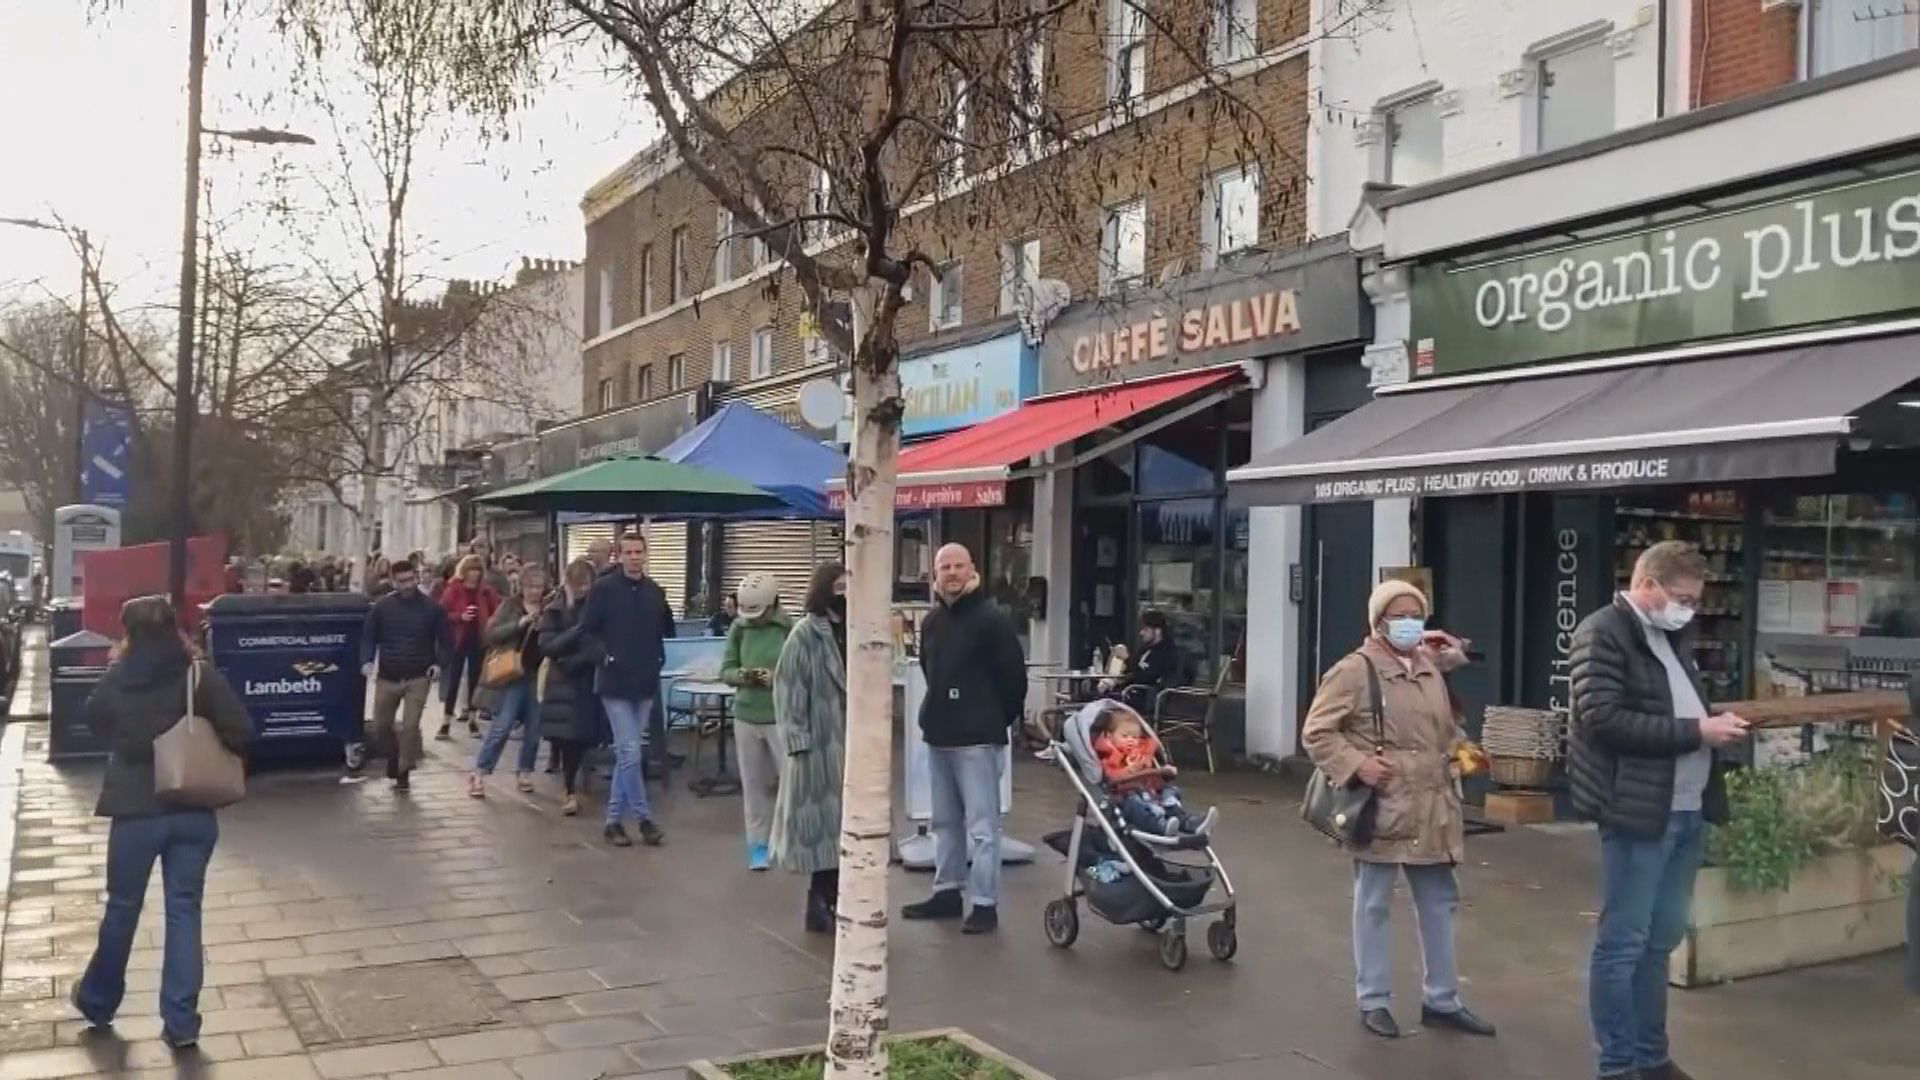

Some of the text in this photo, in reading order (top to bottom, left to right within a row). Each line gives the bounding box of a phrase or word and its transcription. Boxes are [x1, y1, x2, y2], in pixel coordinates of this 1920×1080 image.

[1475, 196, 1920, 332] organic plus
[1072, 289, 1301, 374] CAFFÈ SALVA
[1333, 478, 1383, 496] ORGANIC
[1424, 471, 1480, 491] HEALTHY
[1528, 464, 1574, 483] DRINK
[1576, 463, 1588, 481] &
[1591, 458, 1669, 480] PRODUCE
[1550, 527, 1578, 685] licence
[238, 634, 346, 647] COMMERCIAL WASTE
[245, 677, 322, 695] Lambeth
